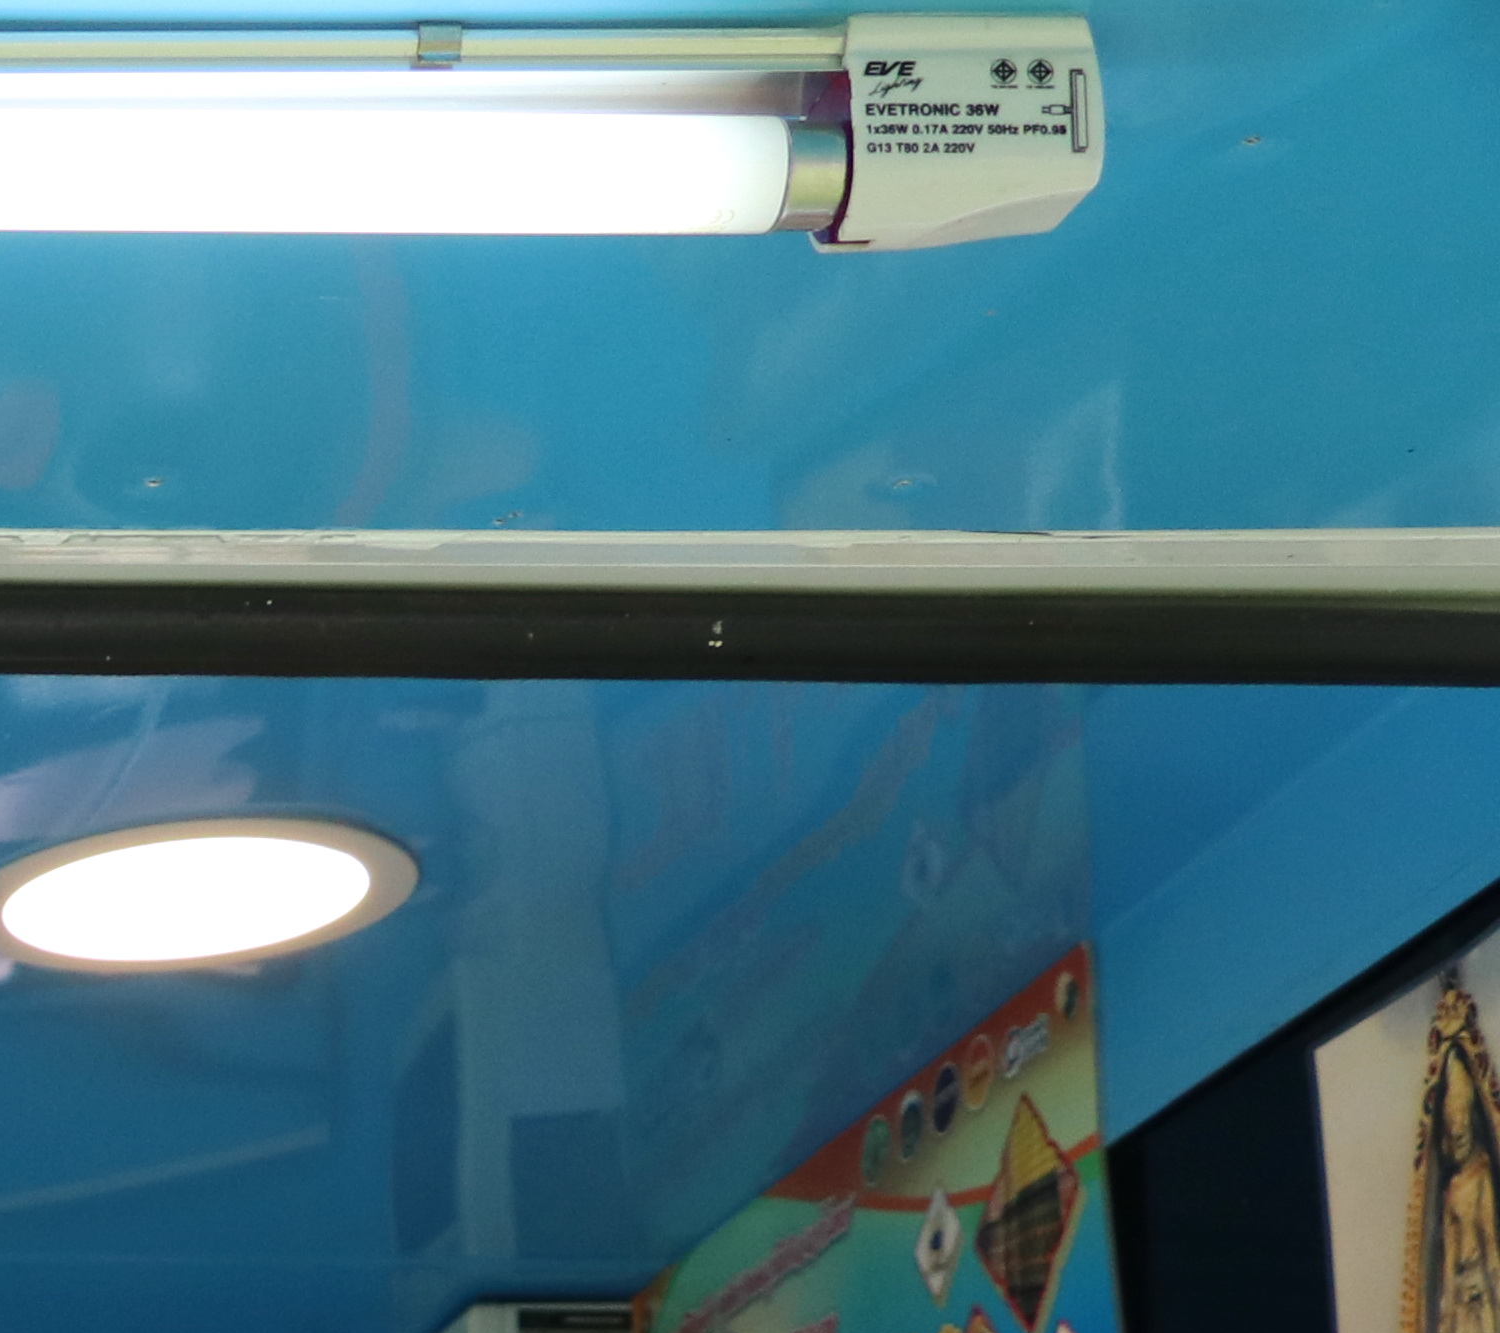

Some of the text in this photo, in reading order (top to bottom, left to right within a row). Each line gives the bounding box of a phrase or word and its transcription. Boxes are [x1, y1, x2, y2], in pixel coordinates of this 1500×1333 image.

[864, 61, 916, 76] EVE
[865, 103, 1000, 116] EVETRONIC 36W
[912, 124, 948, 134] 0.17A
[952, 124, 983, 134] 220V
[987, 124, 1019, 134] 50Hz
[866, 142, 892, 153] G13
[923, 142, 940, 153] 2A
[944, 142, 975, 153] 220V
